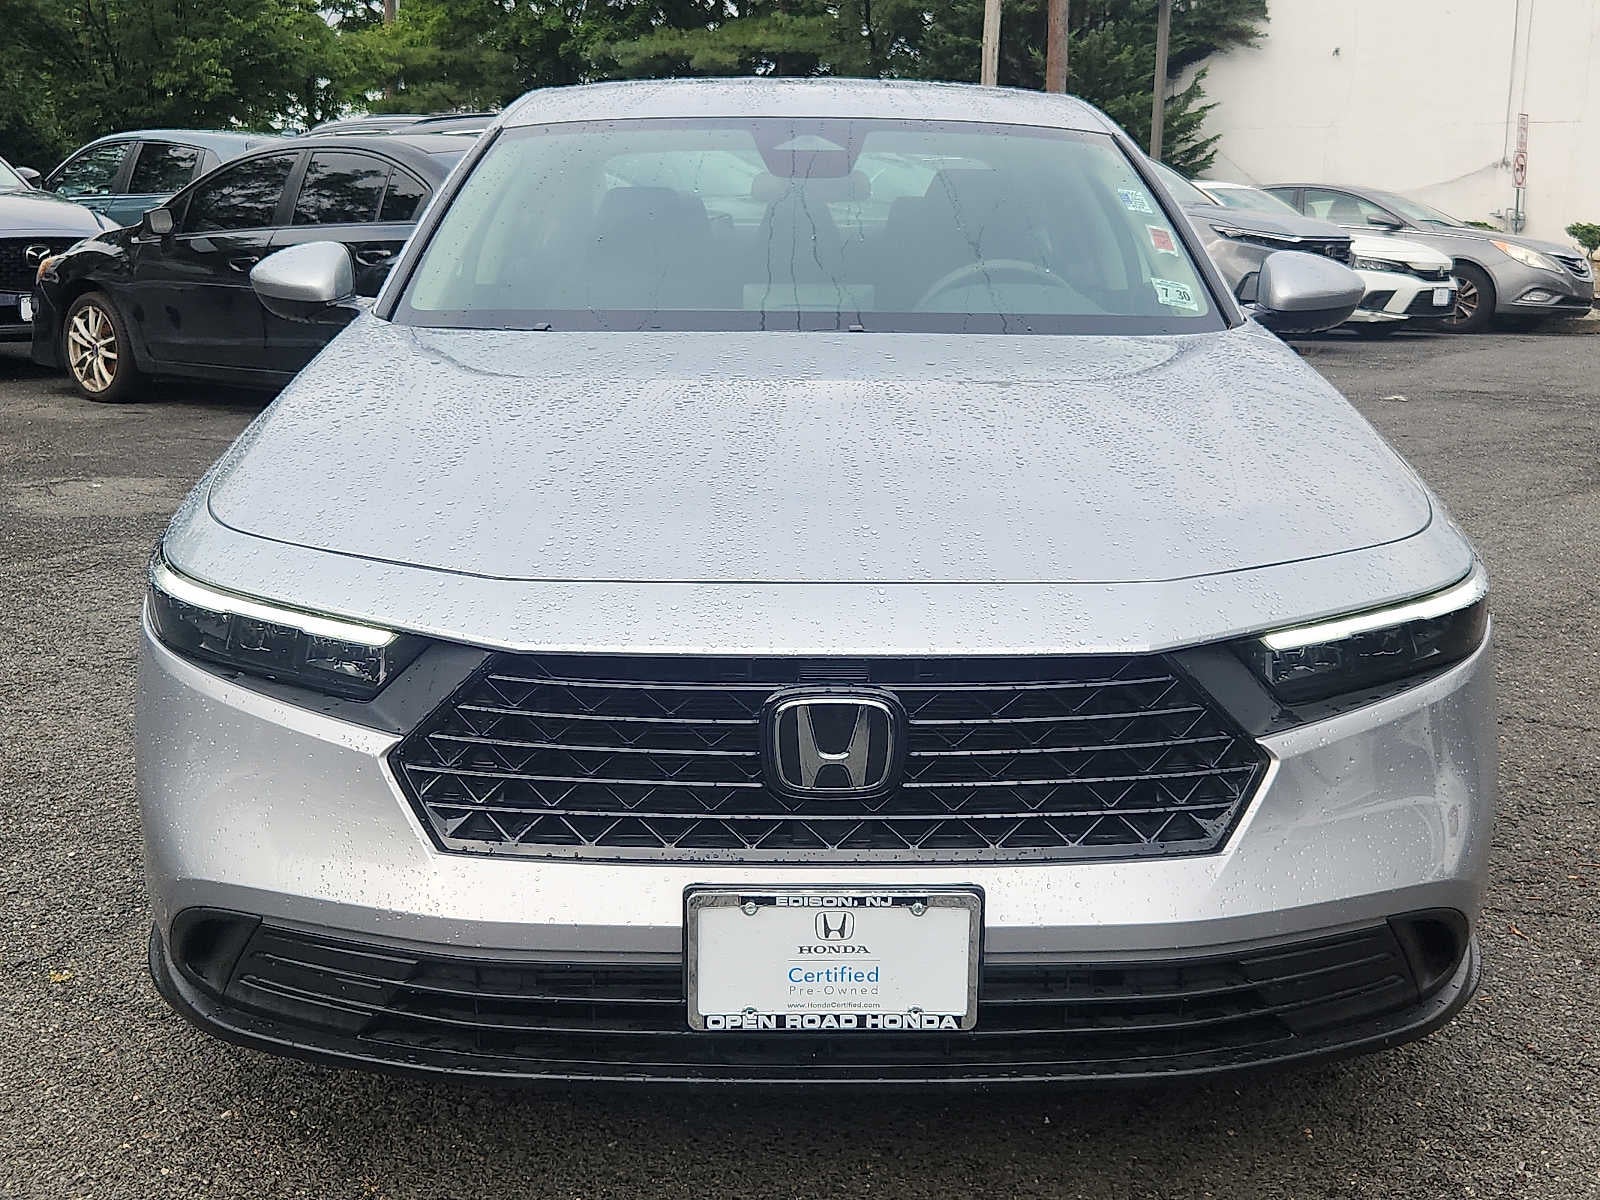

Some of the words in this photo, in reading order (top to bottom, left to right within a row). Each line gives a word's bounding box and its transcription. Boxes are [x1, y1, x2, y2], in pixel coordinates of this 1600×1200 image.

[1161, 287, 1169, 298] 7
[775, 896, 858, 907] EDISON,
[866, 896, 893, 907] NJ
[798, 945, 871, 954] HONDA
[788, 966, 879, 983] Certified
[789, 985, 879, 995] Pre-Owned
[706, 1014, 776, 1029] OPEN
[786, 1014, 857, 1029] ROAD
[866, 1014, 958, 1029] HONDA
